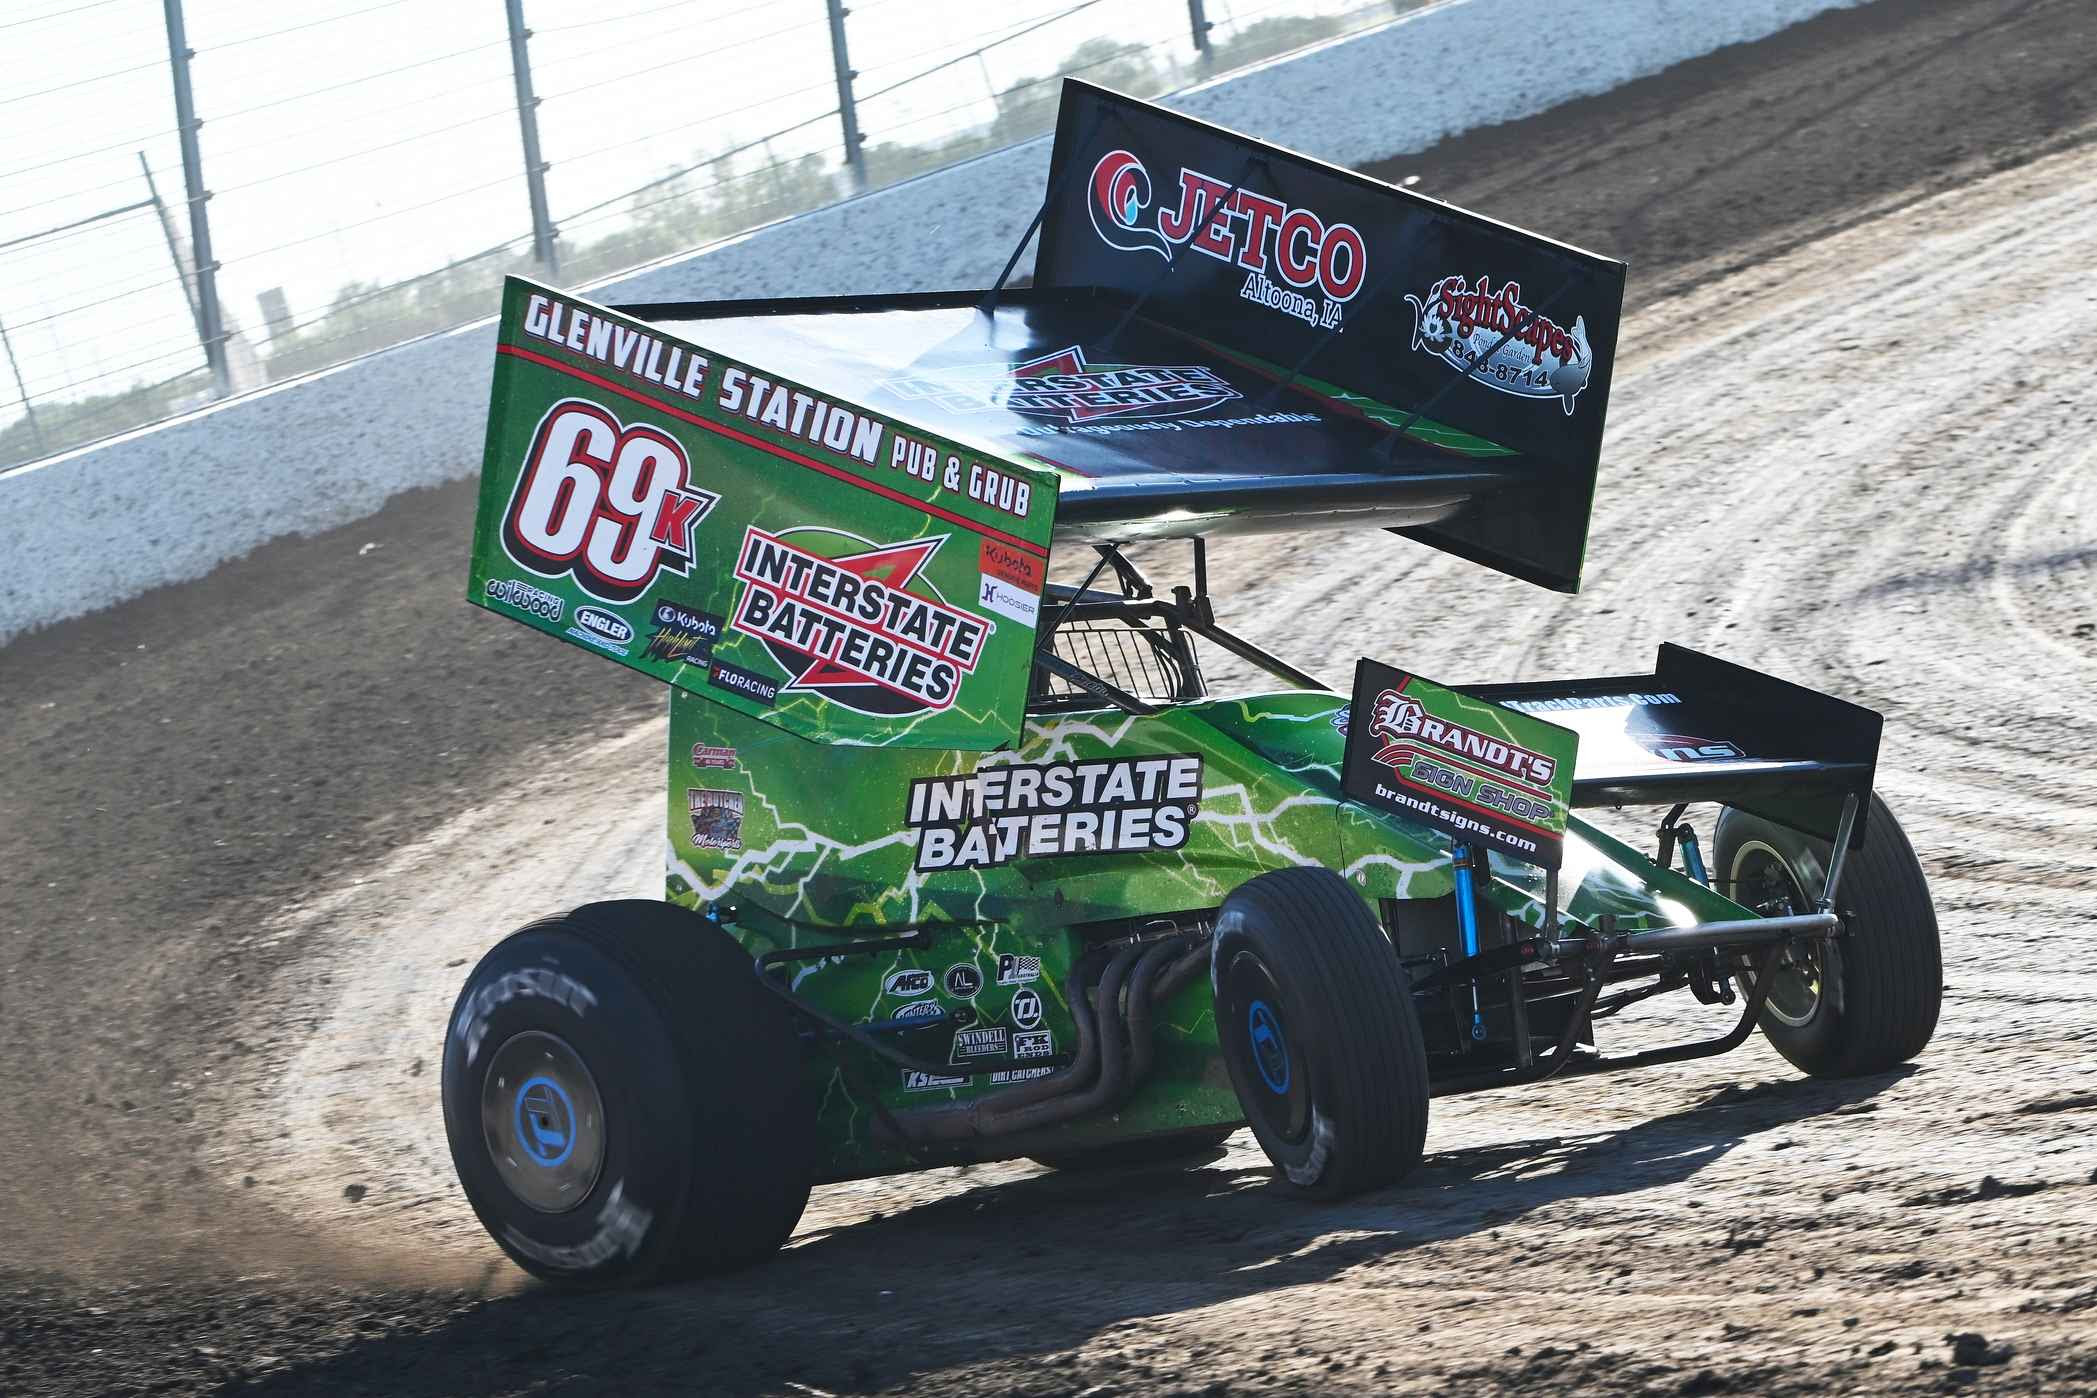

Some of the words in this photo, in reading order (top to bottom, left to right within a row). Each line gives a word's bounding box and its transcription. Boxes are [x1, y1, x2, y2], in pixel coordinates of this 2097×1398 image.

[1158, 167, 1366, 302] JETCO
[1240, 272, 1318, 328] Altoona,
[1437, 276, 1574, 366] SightScapes
[1502, 344, 1531, 363] Garden
[523, 294, 709, 400] GLENVILLE
[719, 367, 884, 466] STATION
[891, 435, 938, 483] PUB
[943, 456, 961, 493] &
[968, 464, 1031, 518] GRUB
[986, 545, 1032, 576] Kubota
[581, 610, 628, 640] ENGLER
[677, 611, 716, 636] Kubota
[743, 538, 980, 662] INTERSTATE
[996, 592, 1035, 614] HOOSIER
[742, 588, 955, 700] BATTERIES
[718, 669, 776, 699] FLORACING
[1370, 692, 1555, 784] BRANDT'S
[909, 758, 1200, 823] INTERSTATE
[1375, 784, 1537, 853] brandtsigns.com
[1412, 761, 1473, 796] SIGN
[1476, 784, 1552, 821] SHOP
[958, 1028, 1005, 1047] SWINDELL
